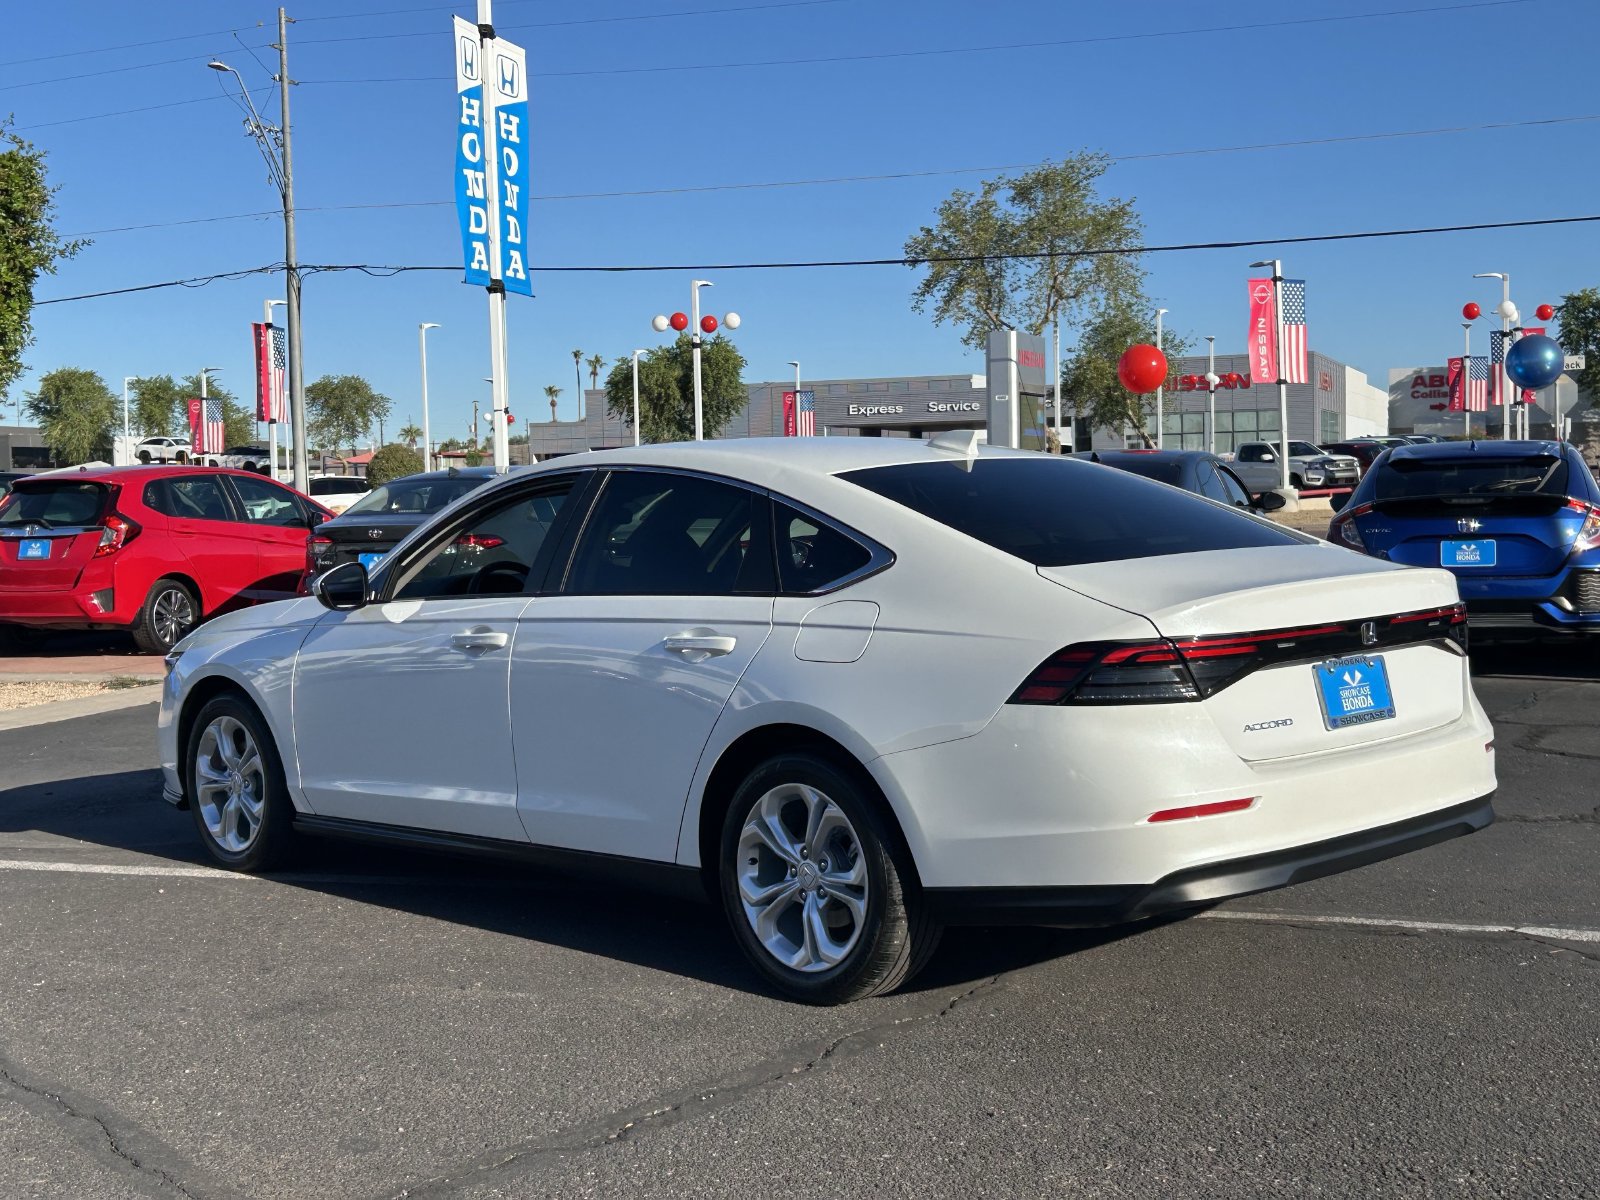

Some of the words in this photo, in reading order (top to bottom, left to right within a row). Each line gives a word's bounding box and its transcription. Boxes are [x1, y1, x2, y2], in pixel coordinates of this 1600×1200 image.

[461, 95, 489, 271] HONDA
[498, 110, 526, 280] HONDA
[1257, 317, 1270, 379] NISSAN
[1411, 375, 1450, 388] AB
[849, 404, 903, 417] Express
[928, 401, 980, 412] Service
[1333, 656, 1367, 667] PHOENIX
[1340, 686, 1371, 699] SHOWCASE
[1342, 695, 1374, 711] HONDA
[1243, 718, 1294, 732] ACCORD
[1341, 710, 1386, 726] SHOWCASE
